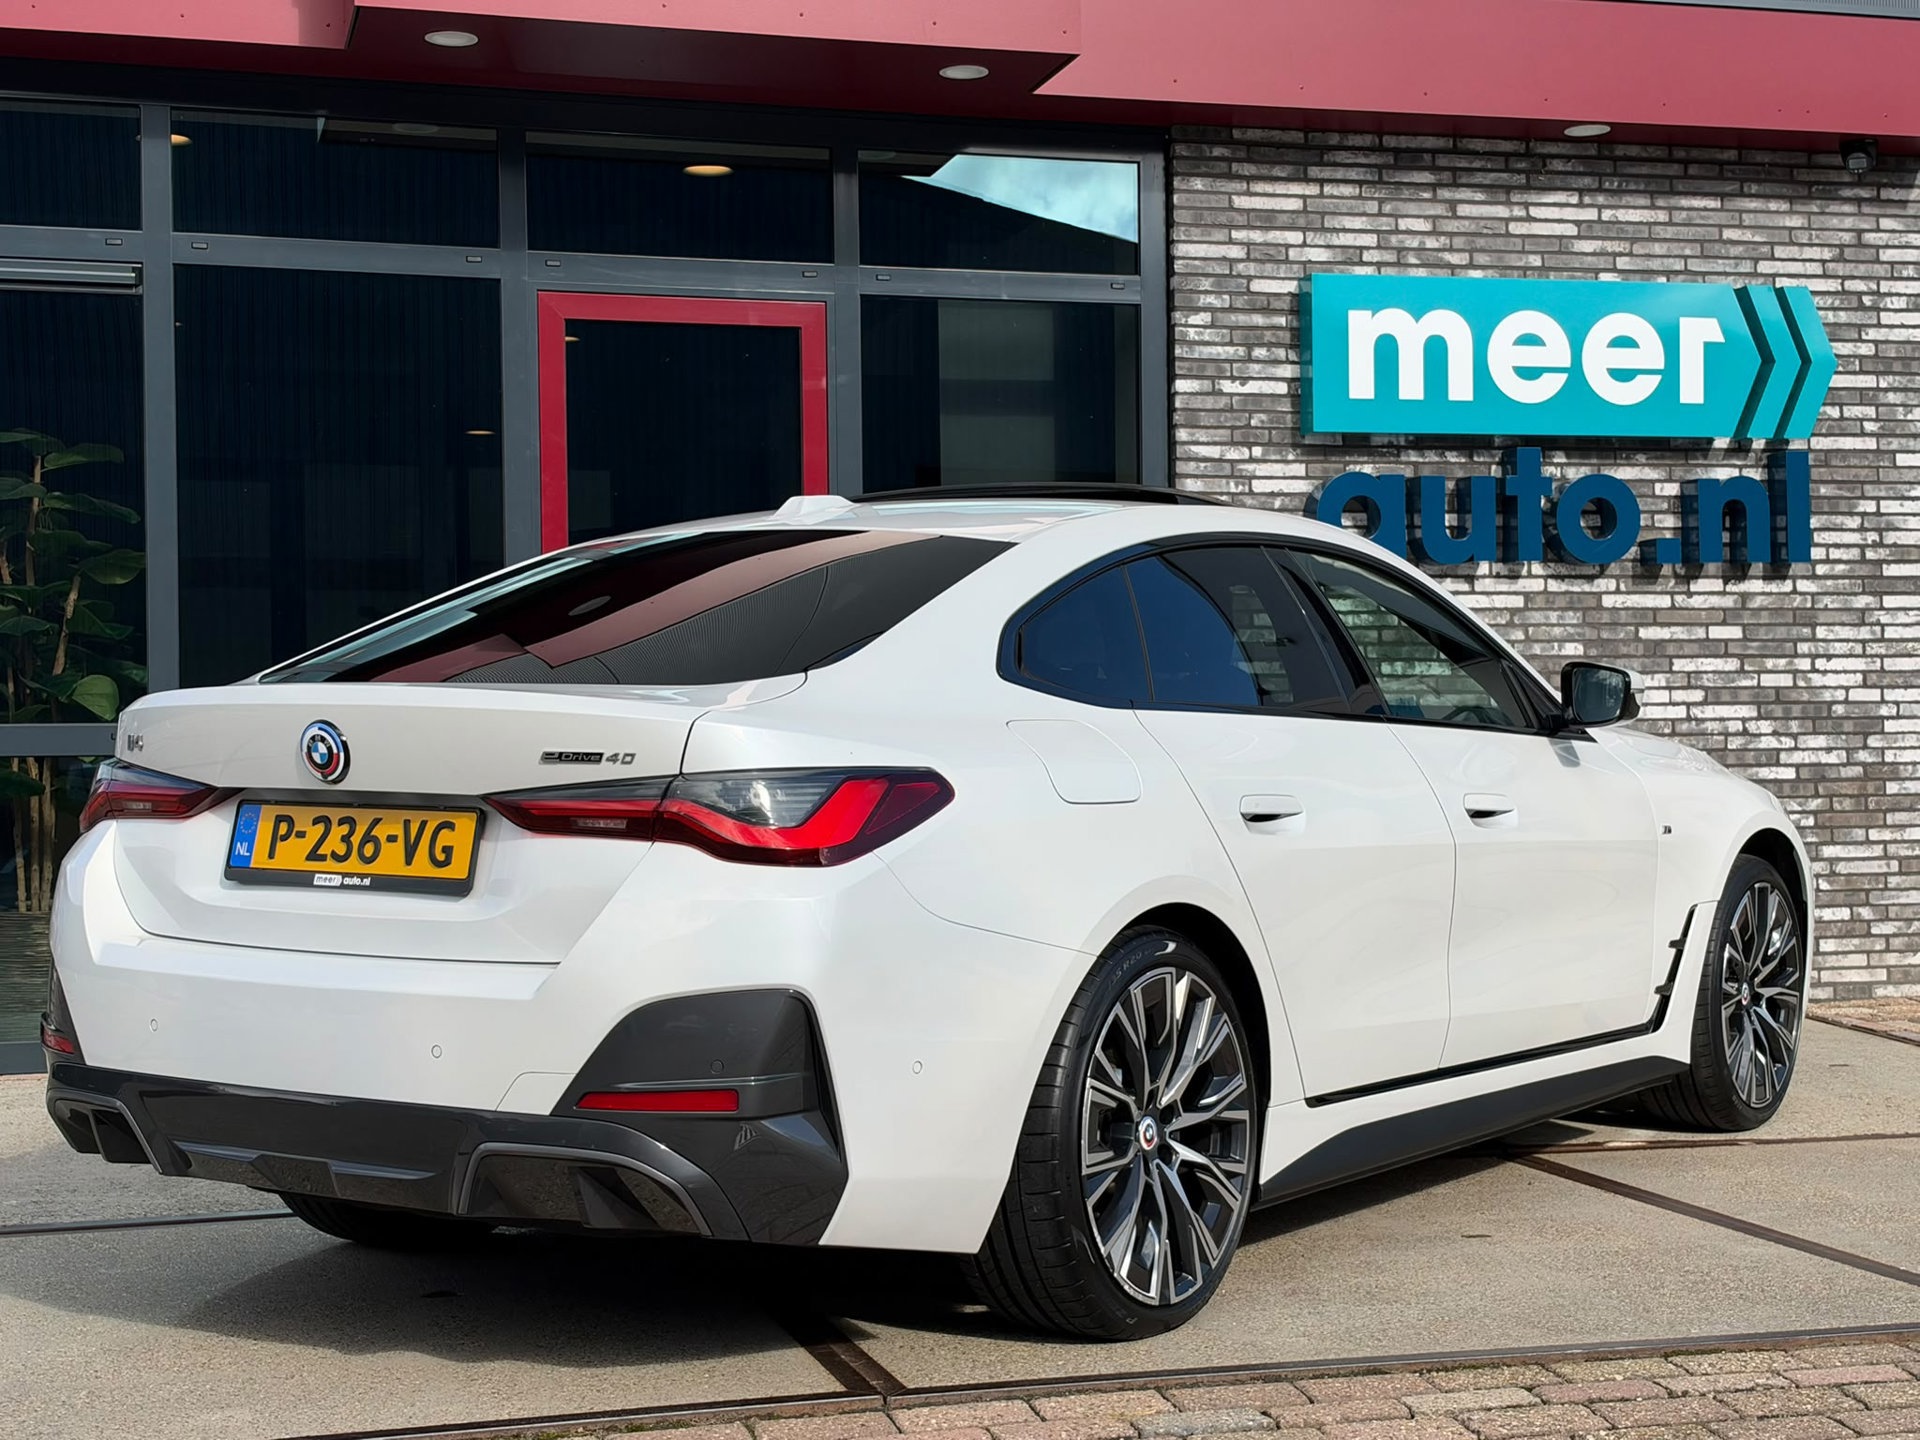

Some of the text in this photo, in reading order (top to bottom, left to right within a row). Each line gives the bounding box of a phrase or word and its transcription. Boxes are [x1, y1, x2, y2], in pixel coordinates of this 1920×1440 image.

[1346, 307, 1726, 406] meer
[1315, 446, 1812, 564] auto.nl
[235, 841, 251, 856] NL
[267, 814, 456, 869] P-236-VG
[315, 875, 371, 886] meer auto.nl
